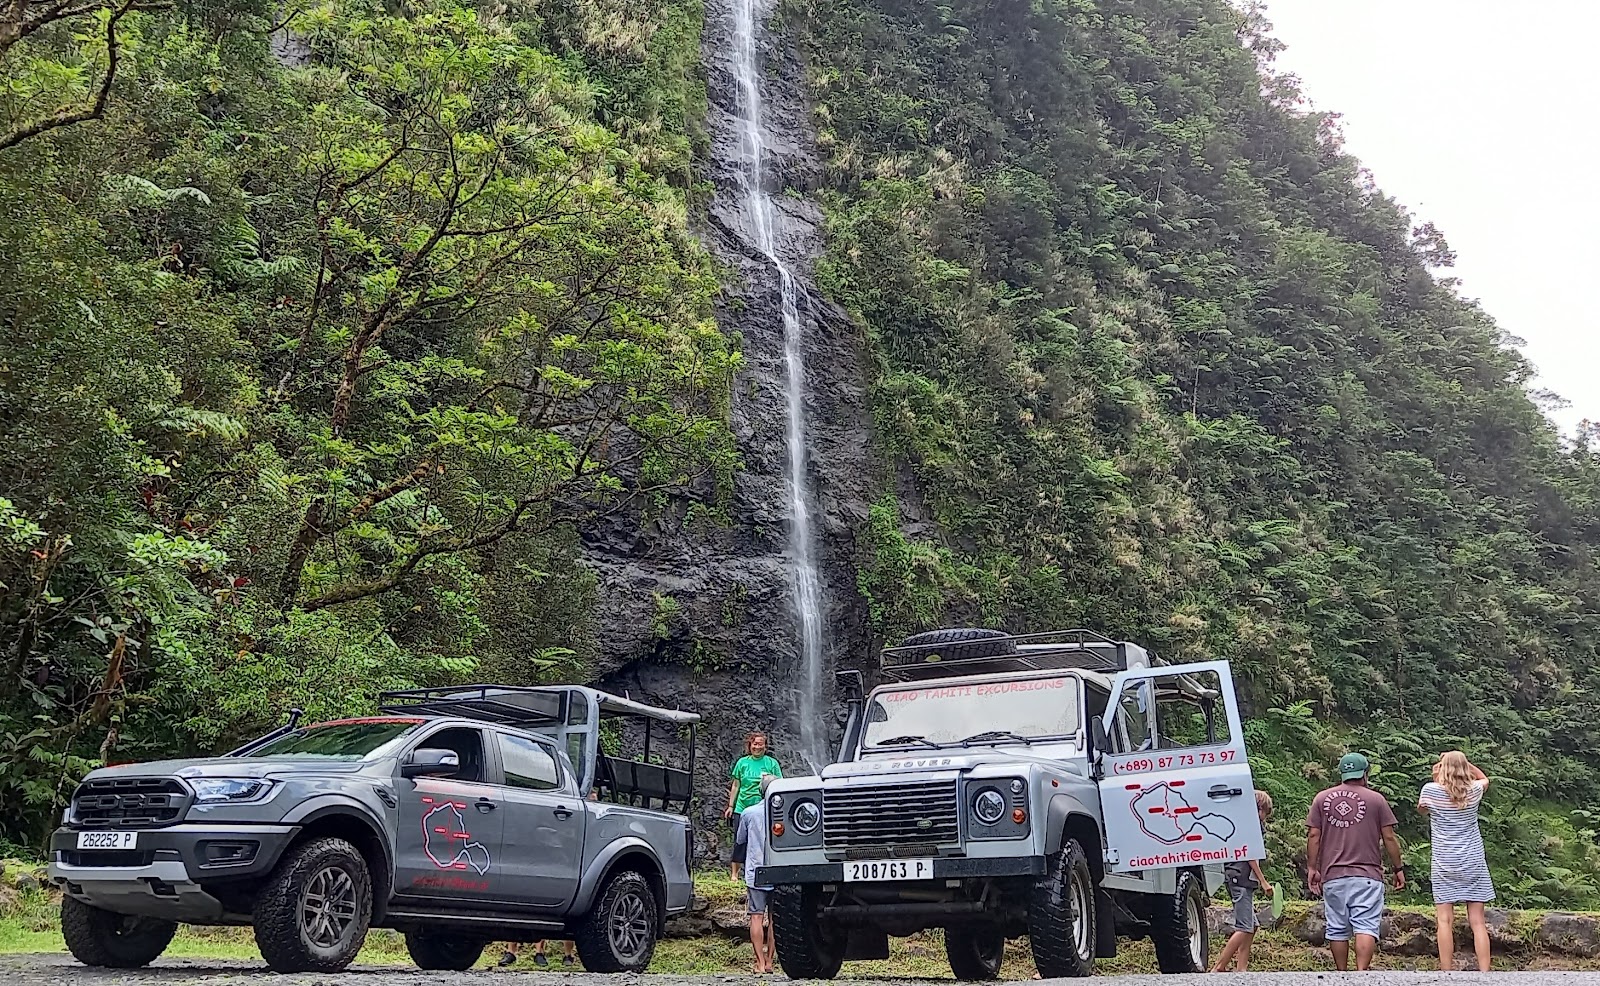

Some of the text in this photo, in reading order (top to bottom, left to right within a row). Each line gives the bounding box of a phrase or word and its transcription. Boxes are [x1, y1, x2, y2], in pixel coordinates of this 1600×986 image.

[886, 680, 1065, 703] CIAO TAHITI EXCURSIONS
[891, 759, 952, 769] ROVER
[1113, 750, 1236, 775] (+689) 87 73 73 97
[1323, 790, 1359, 811] ADVENTURE
[1327, 815, 1350, 828] GOODS
[1353, 800, 1367, 823] READY
[82, 833, 132, 848] 262252 P
[852, 861, 924, 880] 208763 P
